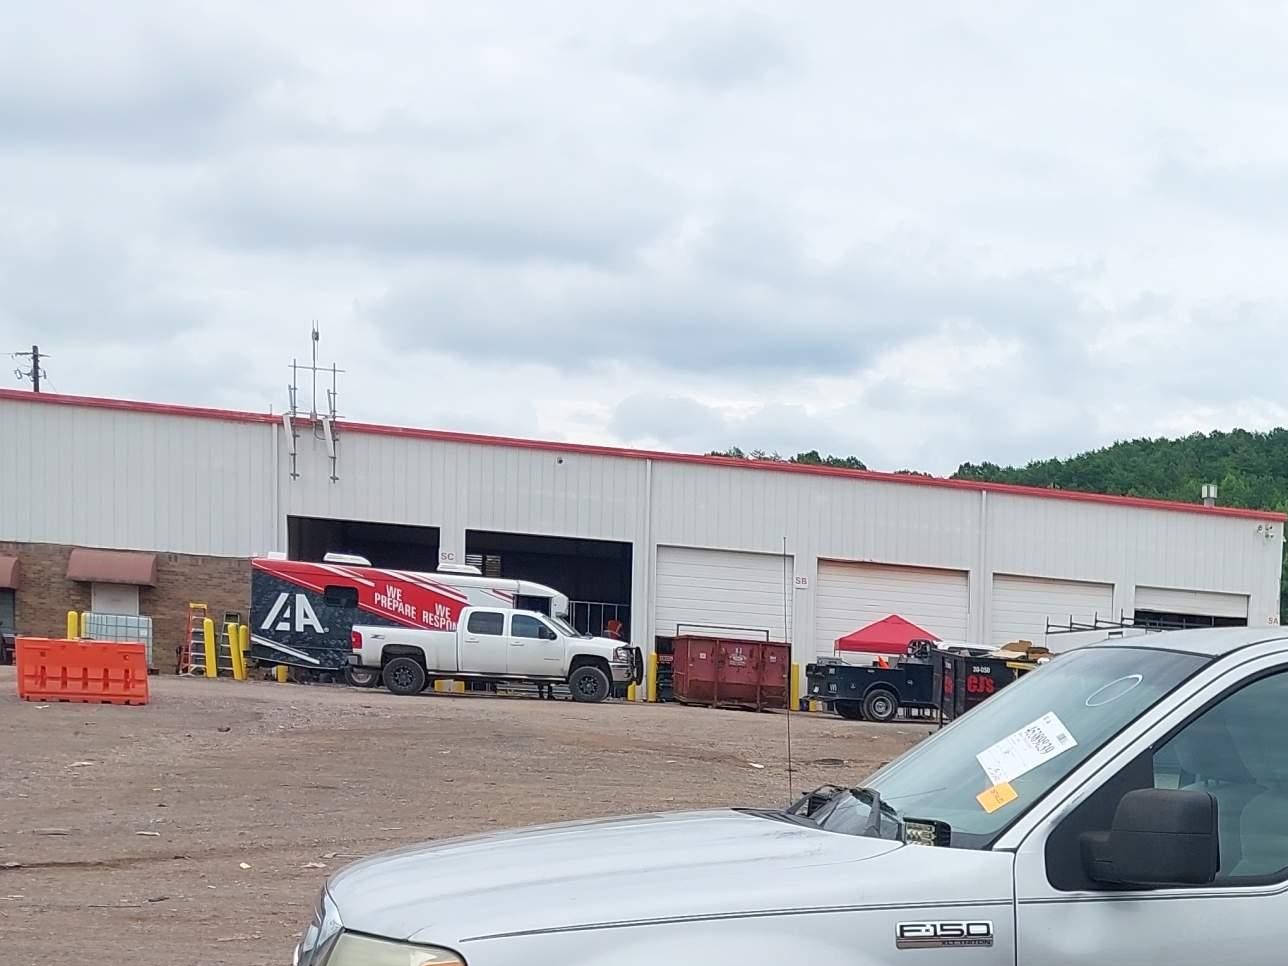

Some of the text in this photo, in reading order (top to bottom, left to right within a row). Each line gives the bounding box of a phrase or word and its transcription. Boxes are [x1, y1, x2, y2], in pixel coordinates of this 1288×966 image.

[441, 552, 455, 561] SC
[795, 576, 807, 585] SB
[386, 584, 403, 602] WE
[374, 592, 416, 620] PREPARE
[435, 602, 451, 620] WE
